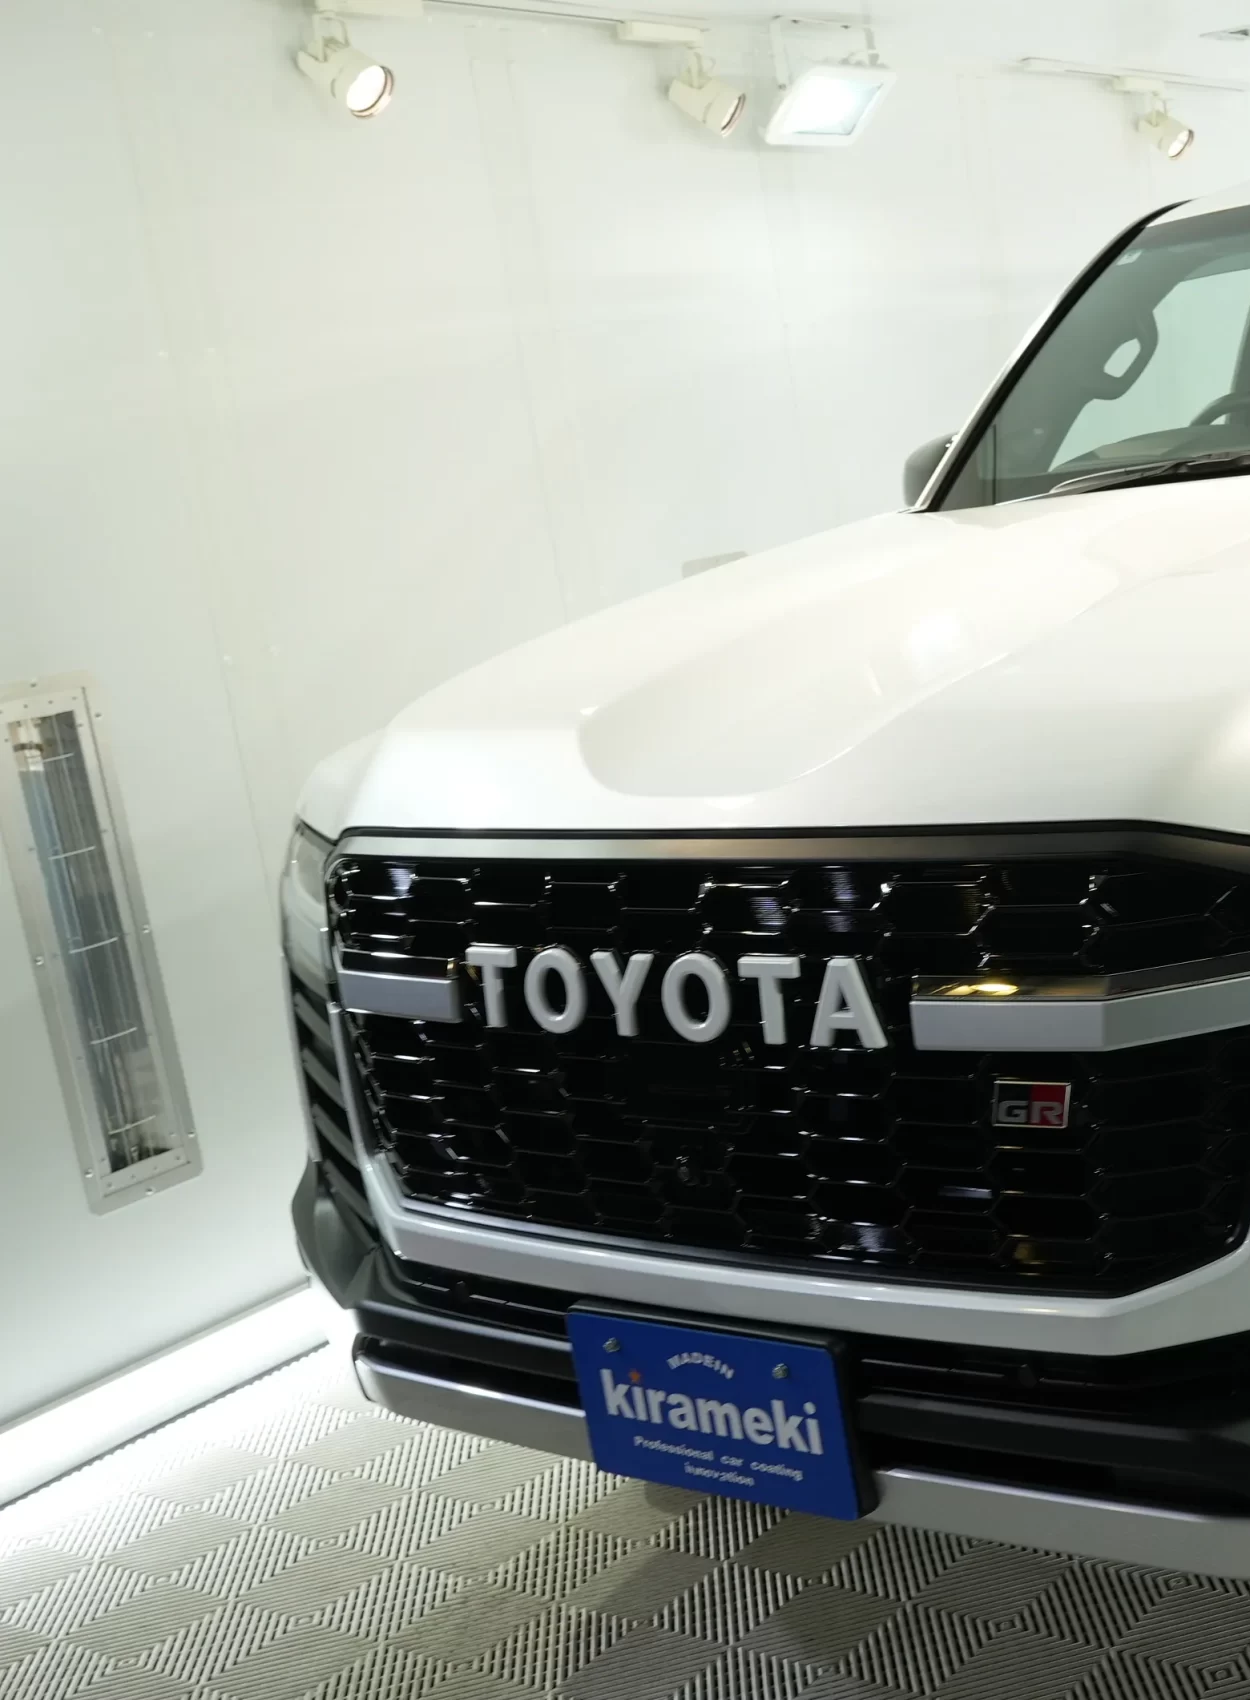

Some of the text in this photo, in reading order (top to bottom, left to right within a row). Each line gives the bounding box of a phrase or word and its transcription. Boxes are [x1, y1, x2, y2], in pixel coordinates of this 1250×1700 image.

[465, 943, 888, 1049] TOYOTA
[998, 1100, 1064, 1125] GR
[600, 1368, 824, 1456] kirameki
[632, 1434, 804, 1482] Professional car coating
[683, 1460, 756, 1488] innovation
